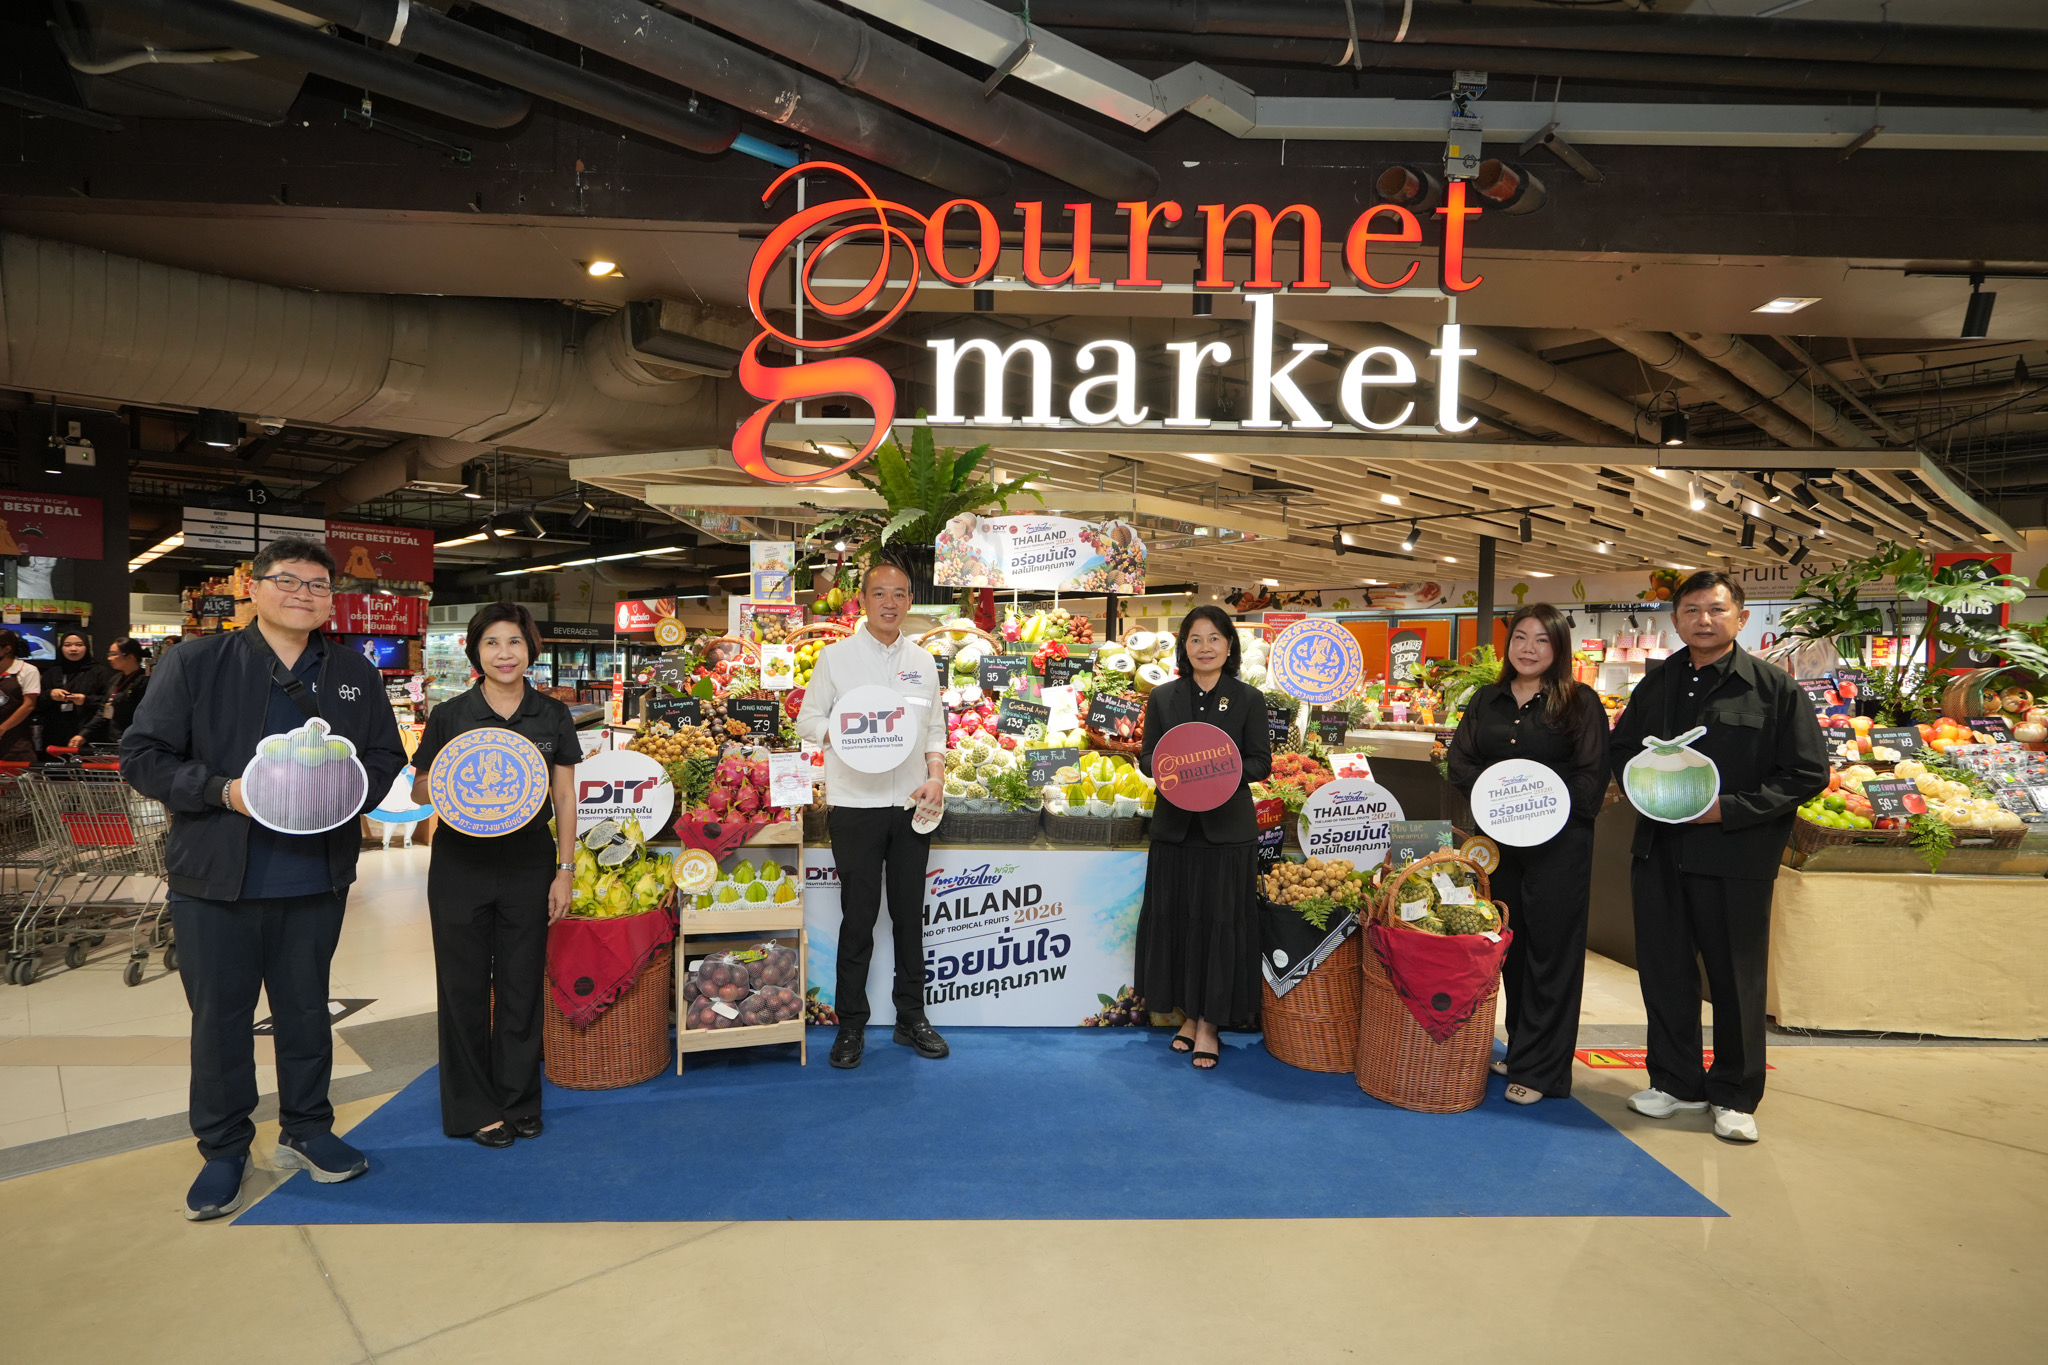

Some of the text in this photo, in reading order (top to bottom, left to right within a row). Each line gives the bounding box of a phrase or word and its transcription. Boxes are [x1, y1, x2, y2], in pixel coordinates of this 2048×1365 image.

[732, 160, 1484, 484] gourmet
[926, 293, 1480, 434] market
[247, 489, 267, 505] 13
[4, 502, 82, 517] BEST DEAL
[332, 530, 364, 540] PRICE
[366, 534, 392, 543] BEST
[393, 536, 420, 546] DEAL
[1012, 531, 1067, 546] THAILAND
[1056, 537, 1074, 546] 2026
[1011, 546, 1077, 567] อร่อยมั่นใจ
[1012, 560, 1075, 575] ผลไม้ไทยคุณภาพ
[203, 600, 231, 611] ALICE
[553, 627, 592, 636] BEVERAGES
[660, 669, 678, 681] 79
[986, 672, 999, 682] 95
[1862, 686, 1875, 697] 89
[677, 716, 692, 728] 89
[1006, 717, 1024, 729] 139
[1092, 712, 1107, 723] 125
[753, 719, 771, 732] 79
[841, 735, 904, 745] กรมการค้าภายใน
[1901, 738, 1913, 747] 69
[1050, 749, 1067, 761] Fruit
[1157, 743, 1234, 791] gourmet
[1180, 758, 1237, 780] market
[1031, 769, 1045, 782] 99
[1488, 780, 1545, 799] THAILAND
[578, 806, 653, 815] กรมการค้าภายใน
[1313, 802, 1387, 819] THAILAND
[1489, 796, 1557, 818] อร่อยมั่นใจ
[1878, 798, 1892, 811] 59
[458, 811, 522, 832] กระทรวงพาณิชย์
[1257, 813, 1282, 825] eller
[1371, 812, 1396, 821] 2026
[1491, 808, 1556, 826] ผลไม้ไทยคุณภาพ
[1310, 821, 1391, 846] อร่อยมั่นใ
[1400, 848, 1415, 859] 65
[923, 884, 1042, 926] AILAND
[936, 928, 946, 936] OF
[947, 921, 983, 934] TROPICAL
[984, 915, 1010, 926] FRUITS
[1014, 901, 1063, 924] 2026
[923, 926, 1071, 984] ร่อยมั่นใจ
[924, 964, 1067, 1006] ไม้ไทยคุณภาพ
